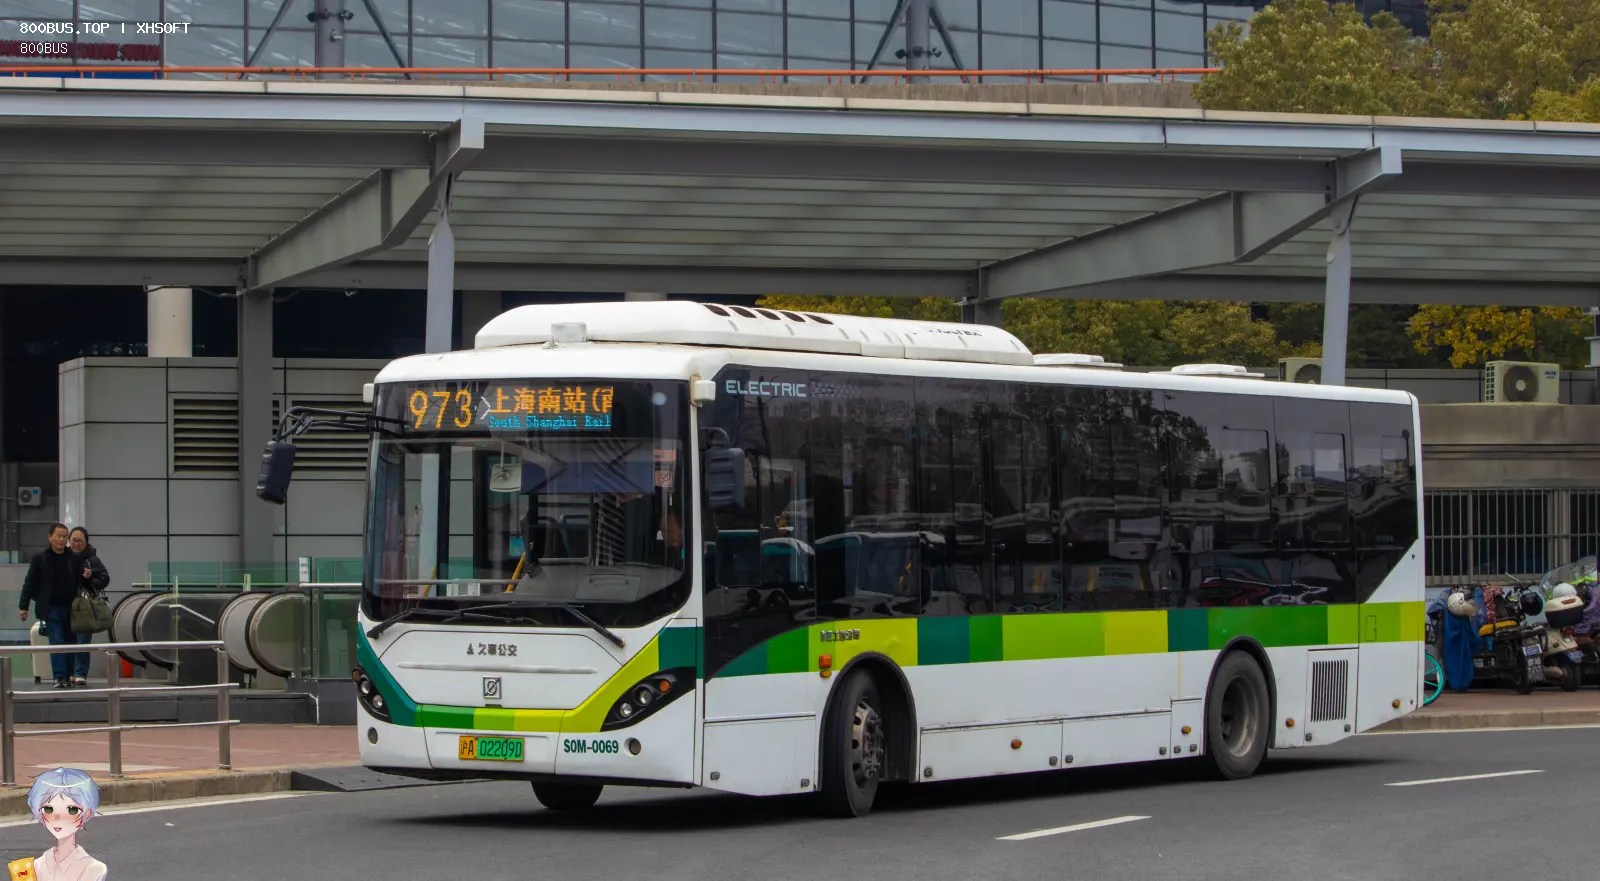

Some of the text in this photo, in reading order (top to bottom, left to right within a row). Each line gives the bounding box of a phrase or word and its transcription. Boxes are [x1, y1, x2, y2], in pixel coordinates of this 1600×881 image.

[726, 380, 807, 398] ELECTRIC
[410, 390, 472, 429] 973
[490, 416, 612, 430] South Shanghai Rail
